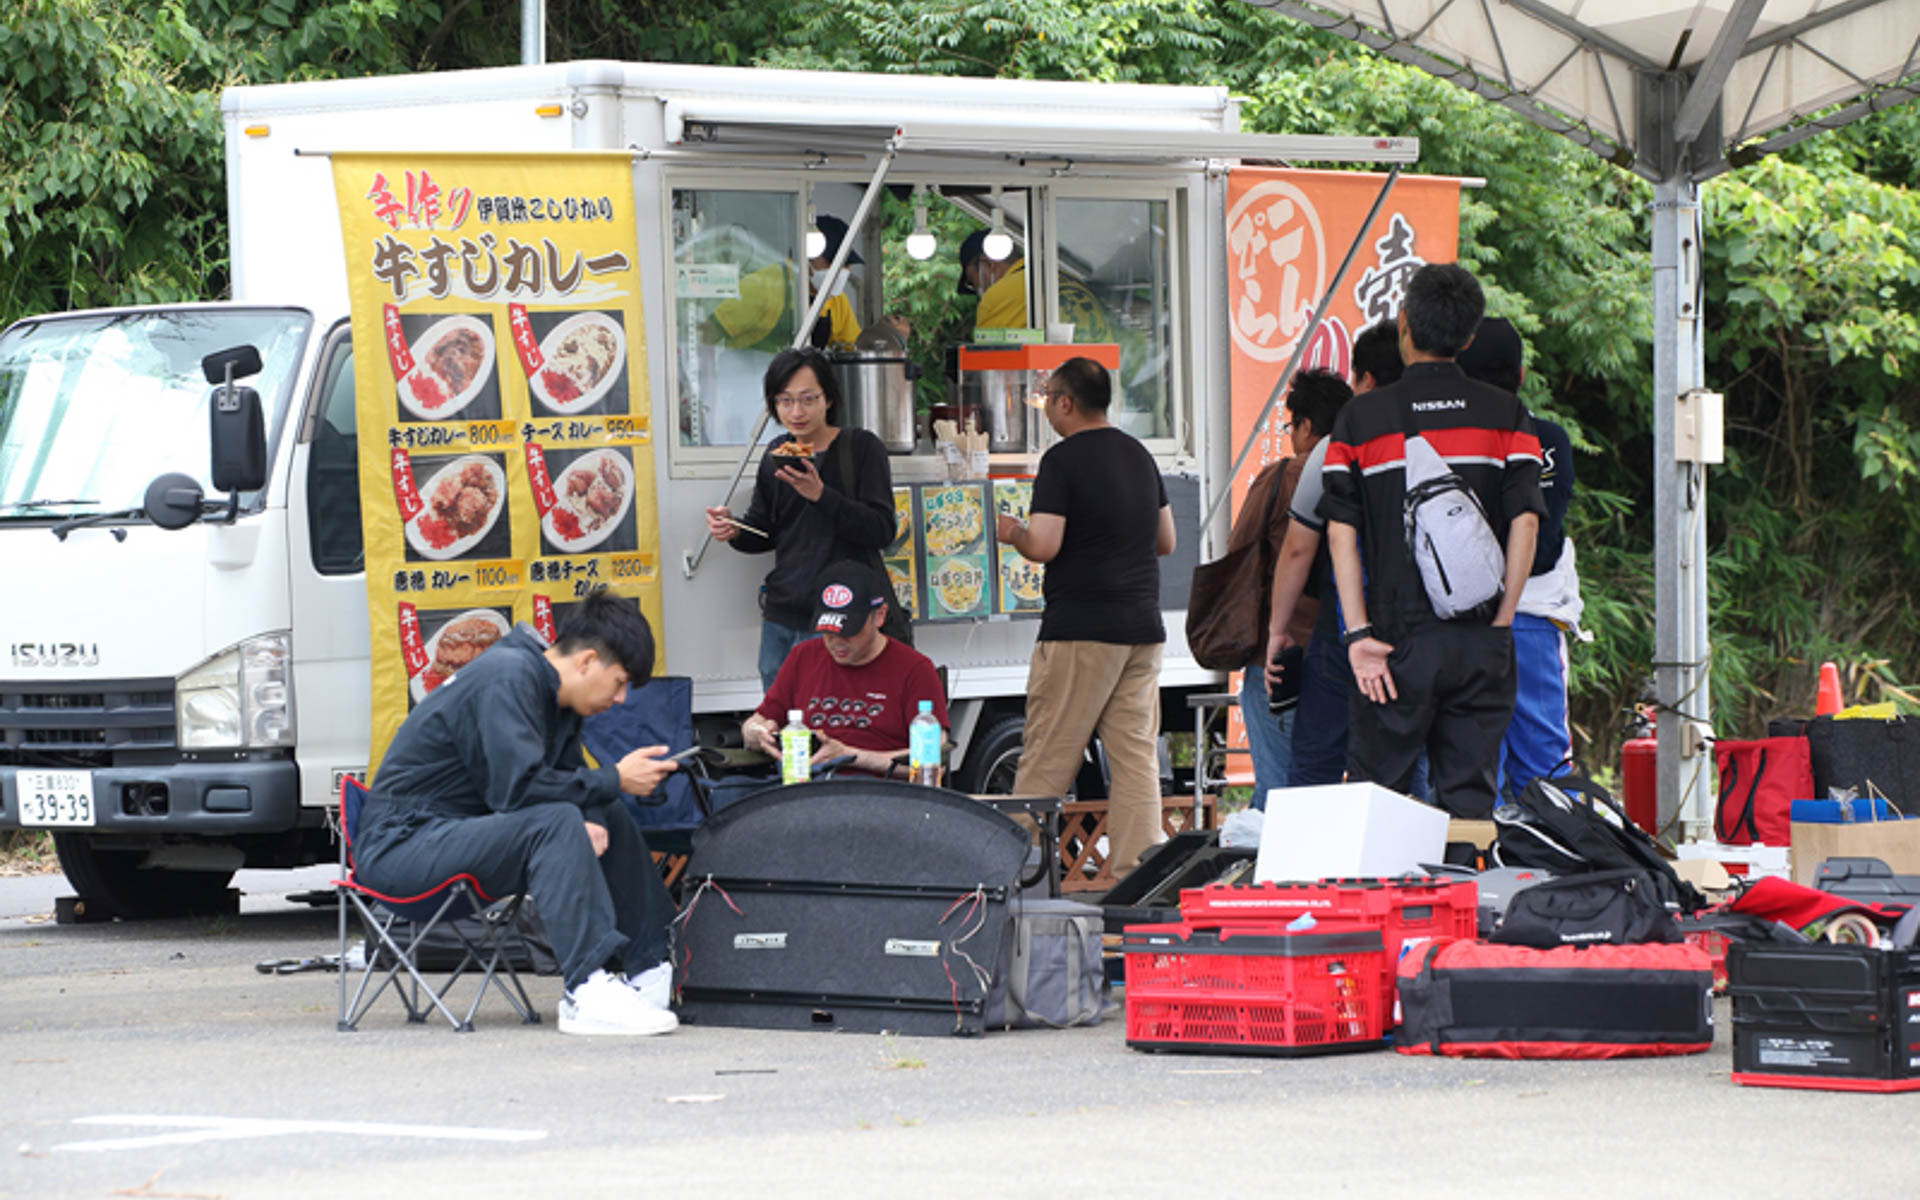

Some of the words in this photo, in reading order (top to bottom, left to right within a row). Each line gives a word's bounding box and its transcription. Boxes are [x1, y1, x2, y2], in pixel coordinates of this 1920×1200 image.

[367, 169, 472, 231] 手作り
[372, 233, 630, 299] 牛すじカレー
[1411, 398, 1466, 413] NISSAN
[388, 425, 467, 449] 牛すじカレー
[469, 423, 499, 446] 800
[430, 567, 470, 588] カレー
[11, 642, 100, 667] ISUZU
